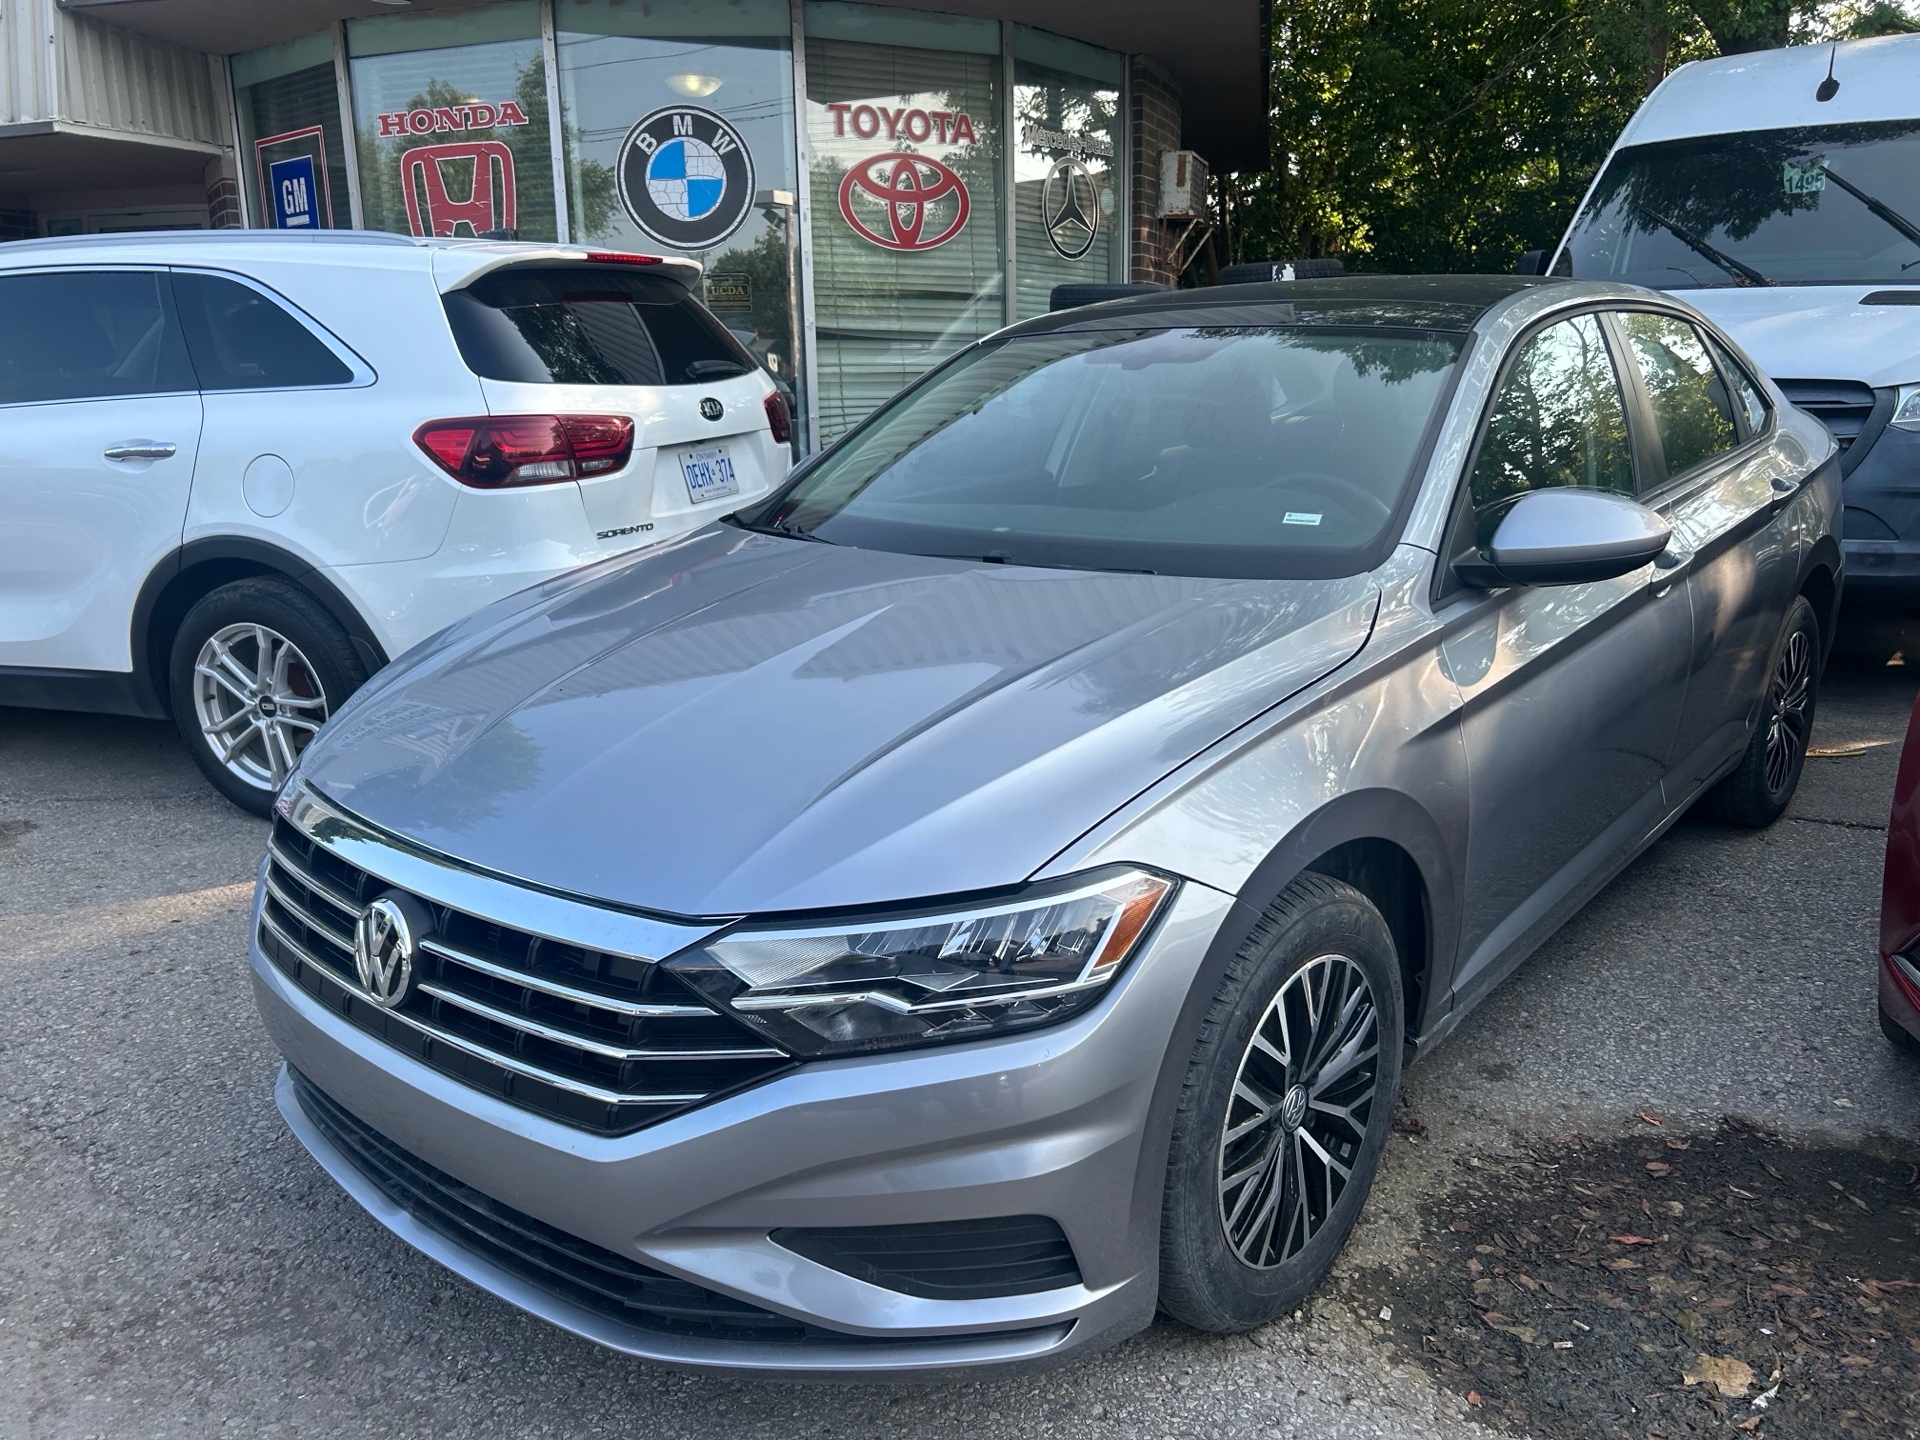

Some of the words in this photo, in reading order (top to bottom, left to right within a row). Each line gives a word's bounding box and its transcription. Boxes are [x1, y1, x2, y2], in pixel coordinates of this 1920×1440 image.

[376, 101, 529, 137] HONDA
[634, 114, 738, 156] BMW
[826, 102, 978, 145] TOYOTA
[1023, 123, 1114, 157] Mercedes-Benz
[281, 176, 309, 215] GM
[710, 286, 746, 295] UCDA
[703, 401, 724, 417] KIA
[686, 461, 714, 489] DEHX
[715, 457, 736, 483] 374
[597, 522, 654, 540] SORENTO
